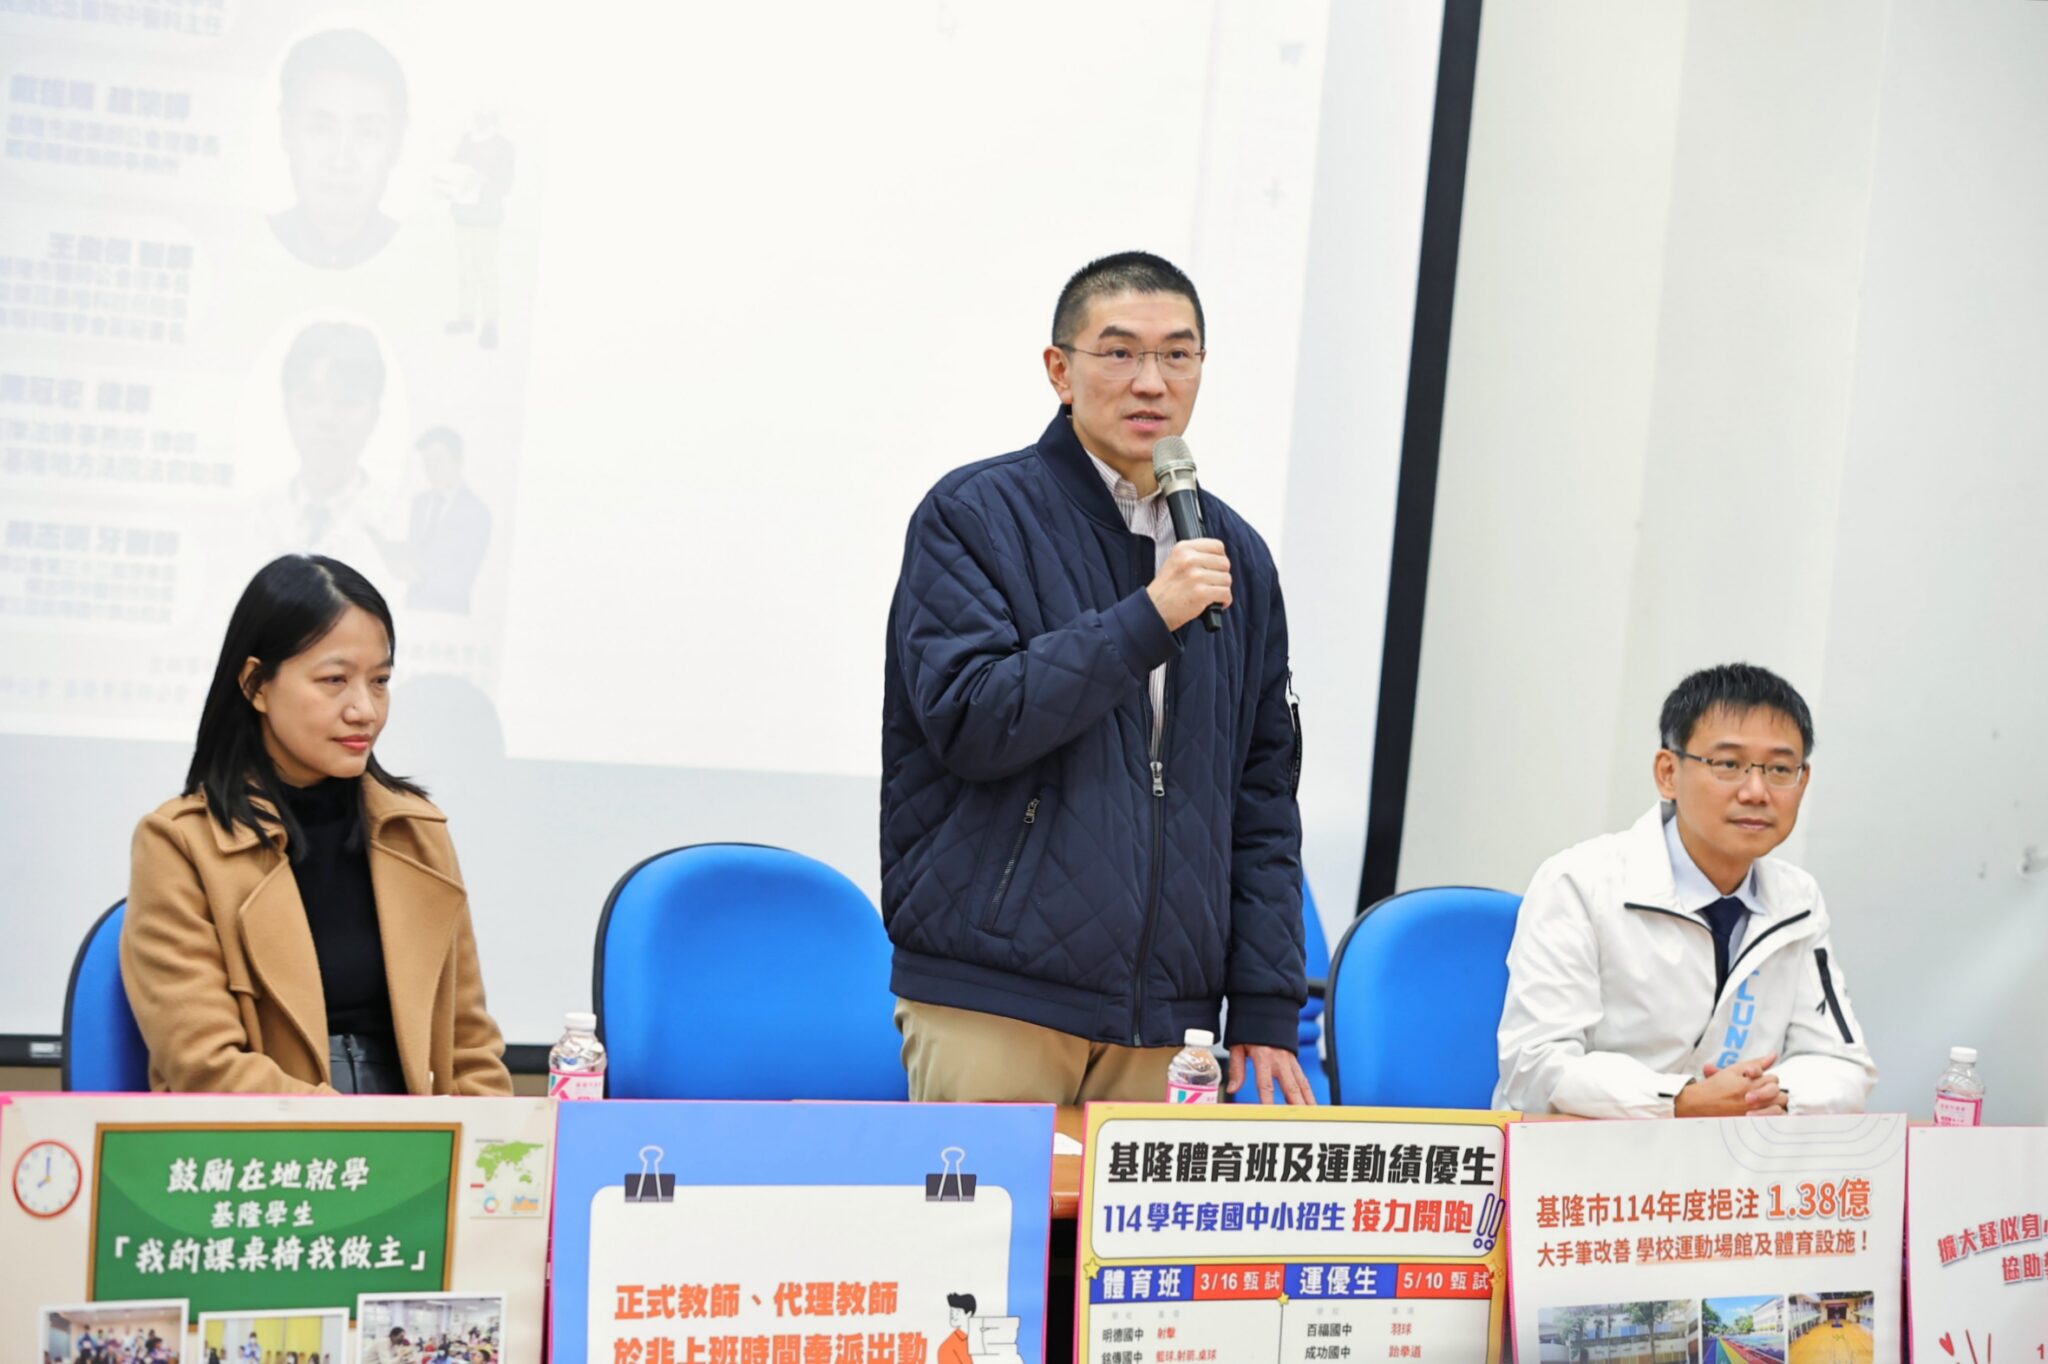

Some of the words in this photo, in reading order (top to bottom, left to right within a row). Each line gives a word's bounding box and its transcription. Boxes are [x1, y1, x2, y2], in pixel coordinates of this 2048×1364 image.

[167, 1157, 371, 1194] 鼓勵在地就學
[1108, 1142, 1497, 1186] 基隆體育班及運動績優生
[210, 1200, 315, 1228] 基隆學生
[1103, 1200, 1346, 1232] 114學年度國中小招生
[1536, 1187, 1760, 1229] 基隆市114年度挹注
[1767, 1177, 1872, 1221] 1.38億
[1537, 1238, 1631, 1268] 大手筆改善
[1937, 1213, 2048, 1264] 擴大疑似身
[114, 1236, 428, 1275] 「我的課桌椅我做主」
[1103, 1268, 1181, 1299] 體育班
[1200, 1272, 1238, 1291] 3/16
[1243, 1269, 1280, 1291] 甄試
[1300, 1265, 1377, 1296] 運優生
[1404, 1271, 1443, 1290] 5/10
[1450, 1269, 1489, 1291] 甄試
[614, 1281, 899, 1320] 正式教師、代理教師
[1102, 1328, 1144, 1343] 明德國中
[1307, 1323, 1352, 1337] 百福國中
[1391, 1323, 1413, 1335] 羽球
[1305, 1345, 1351, 1360] 成功國中
